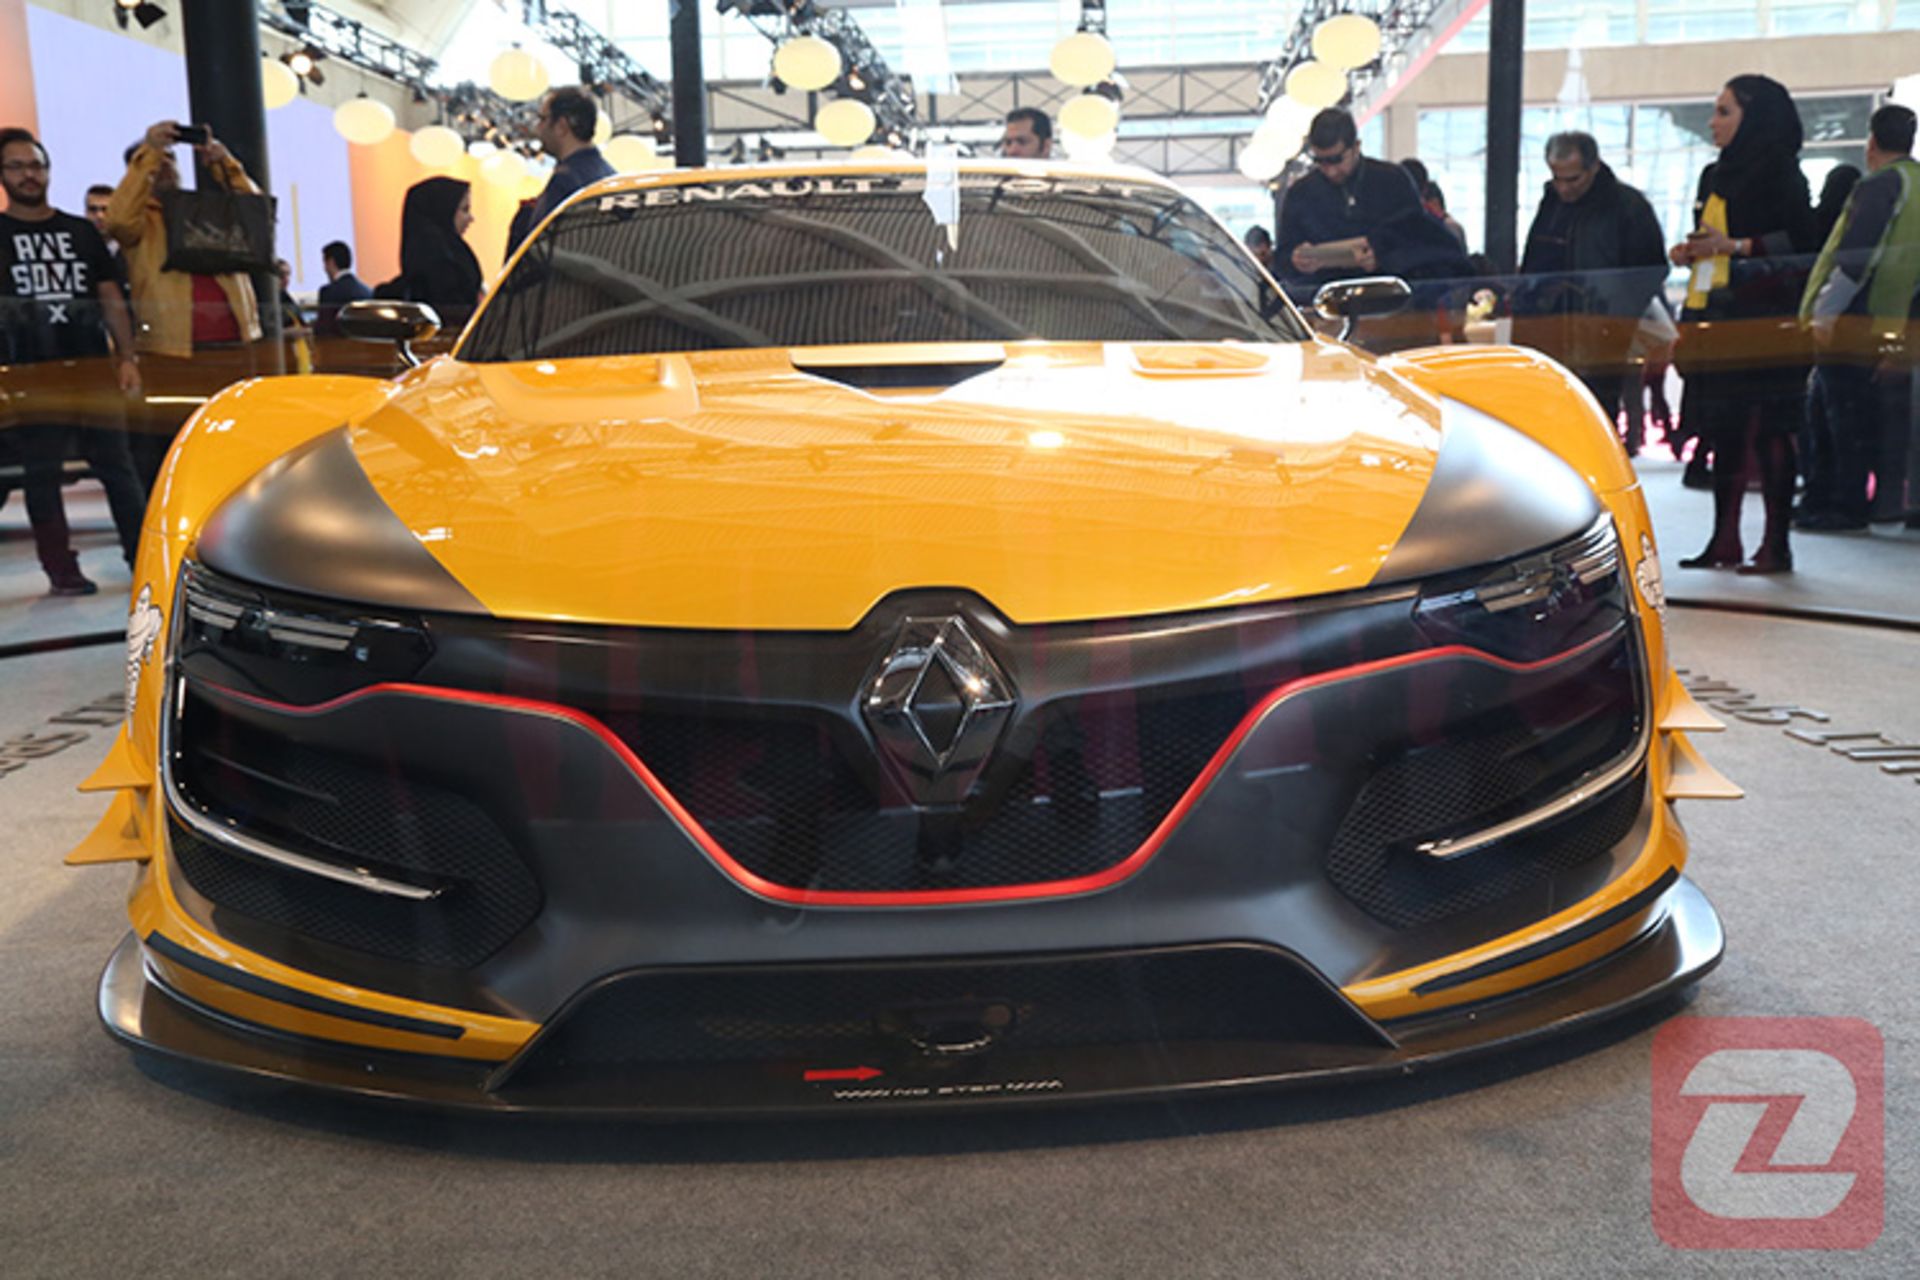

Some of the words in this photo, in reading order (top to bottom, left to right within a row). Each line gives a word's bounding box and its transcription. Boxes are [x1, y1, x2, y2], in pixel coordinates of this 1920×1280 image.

[597, 177, 884, 212] RENAULT
[13, 232, 77, 260] AWE
[11, 262, 88, 295] SOME
